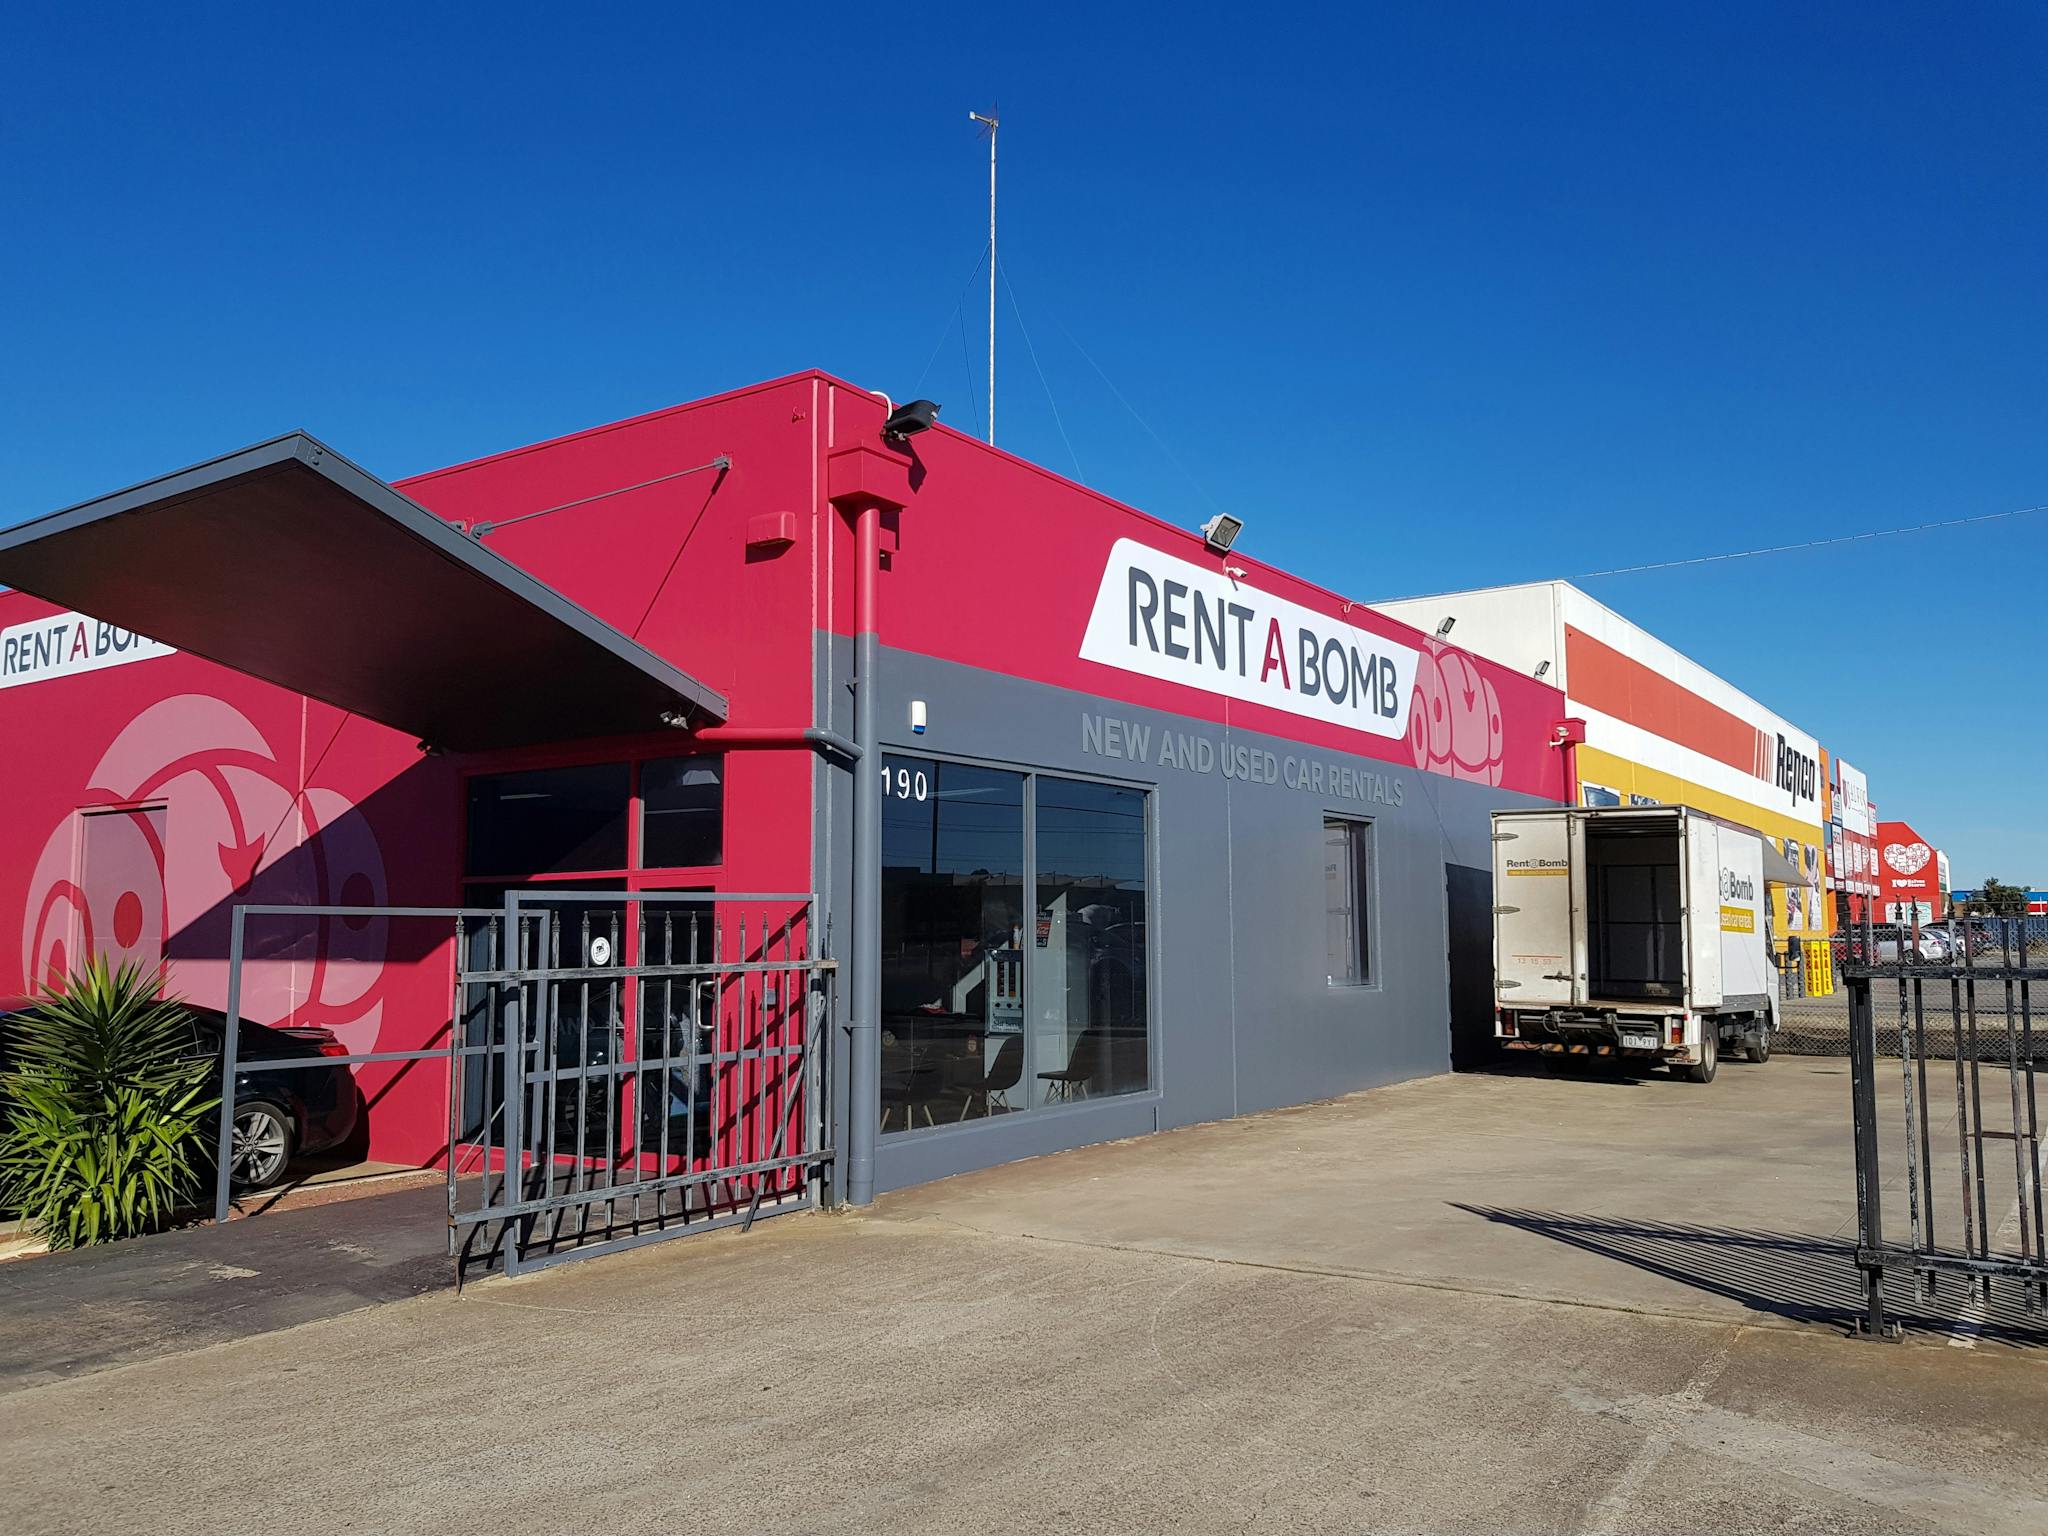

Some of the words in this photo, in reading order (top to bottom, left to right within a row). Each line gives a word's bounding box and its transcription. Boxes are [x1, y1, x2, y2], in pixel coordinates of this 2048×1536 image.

[3, 624, 69, 676] RENT
[69, 621, 89, 662] A
[95, 620, 157, 656] BO
[1128, 566, 1255, 677] RENT
[1260, 617, 1291, 690] A
[1299, 627, 1399, 720] BOMB
[881, 766, 927, 801] 190
[1081, 713, 1150, 763] NEW
[1158, 730, 1216, 774] AND
[1220, 743, 1279, 785] USED
[1283, 755, 1325, 795] CAR
[1328, 765, 1404, 808] RENTALS
[1776, 732, 1816, 807] Repco
